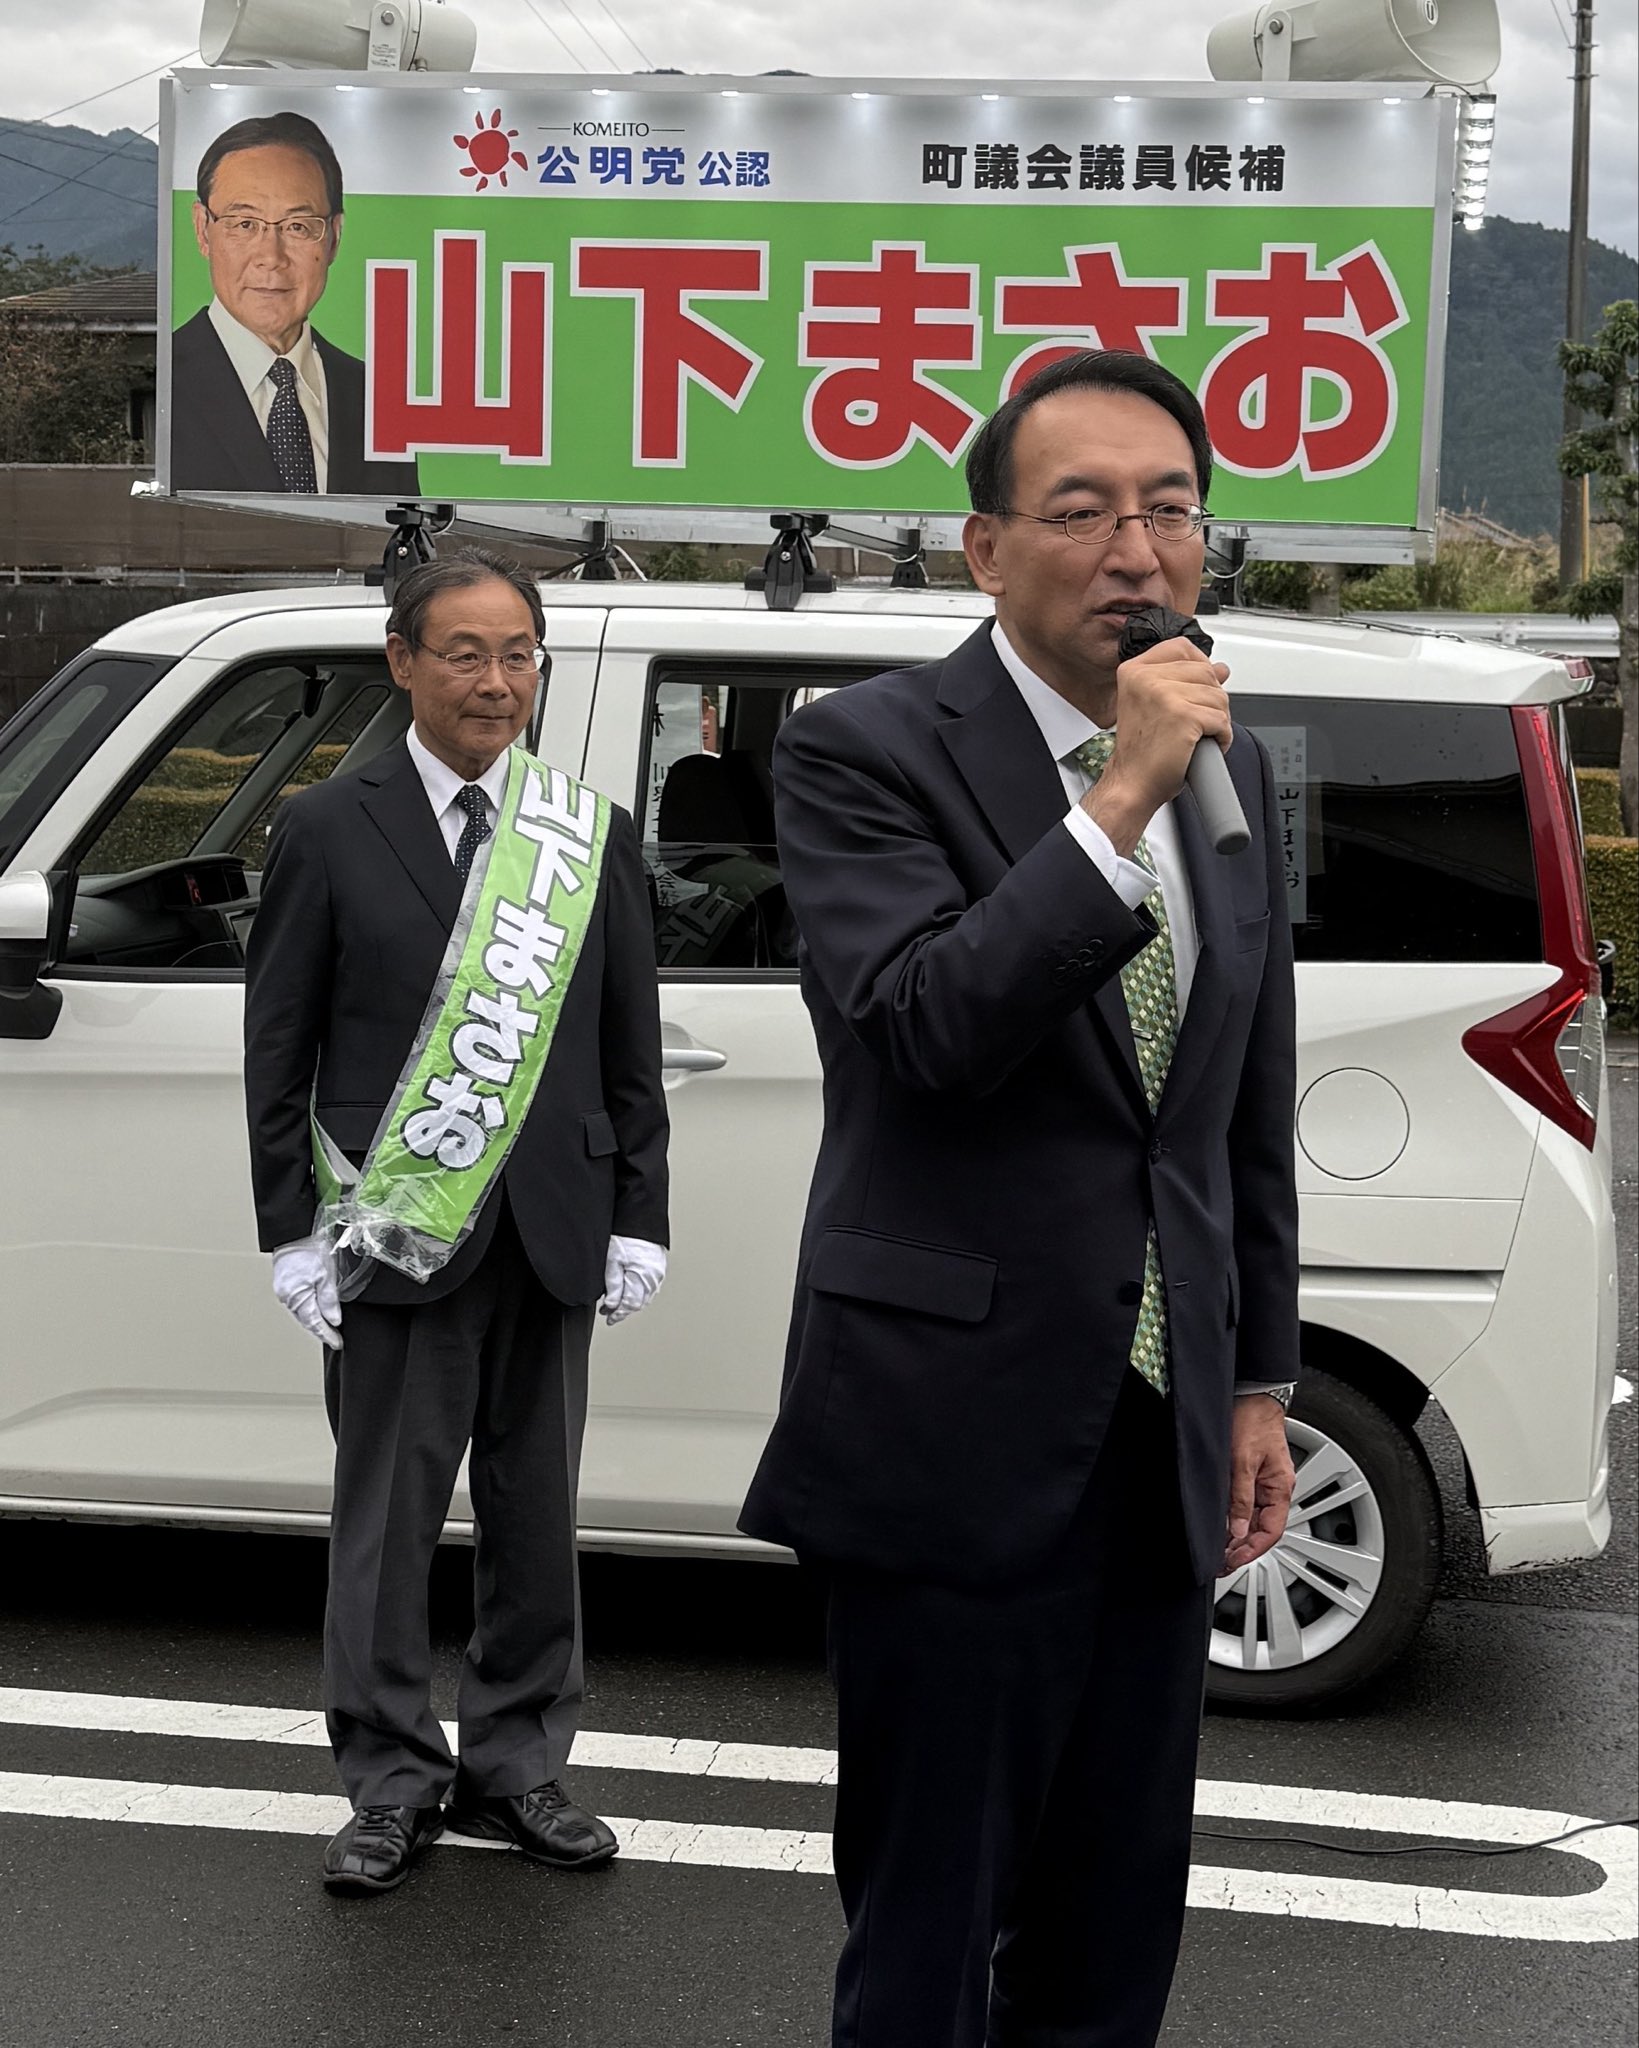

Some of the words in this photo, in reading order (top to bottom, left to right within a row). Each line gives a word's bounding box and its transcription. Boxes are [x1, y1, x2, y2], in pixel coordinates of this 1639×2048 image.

[573, 122, 650, 137] KOMEITO
[537, 145, 685, 185] 公明党
[697, 151, 771, 187] 公認
[922, 143, 1285, 191] 町議会議員候補
[402, 767, 597, 1172] 山下まさお
